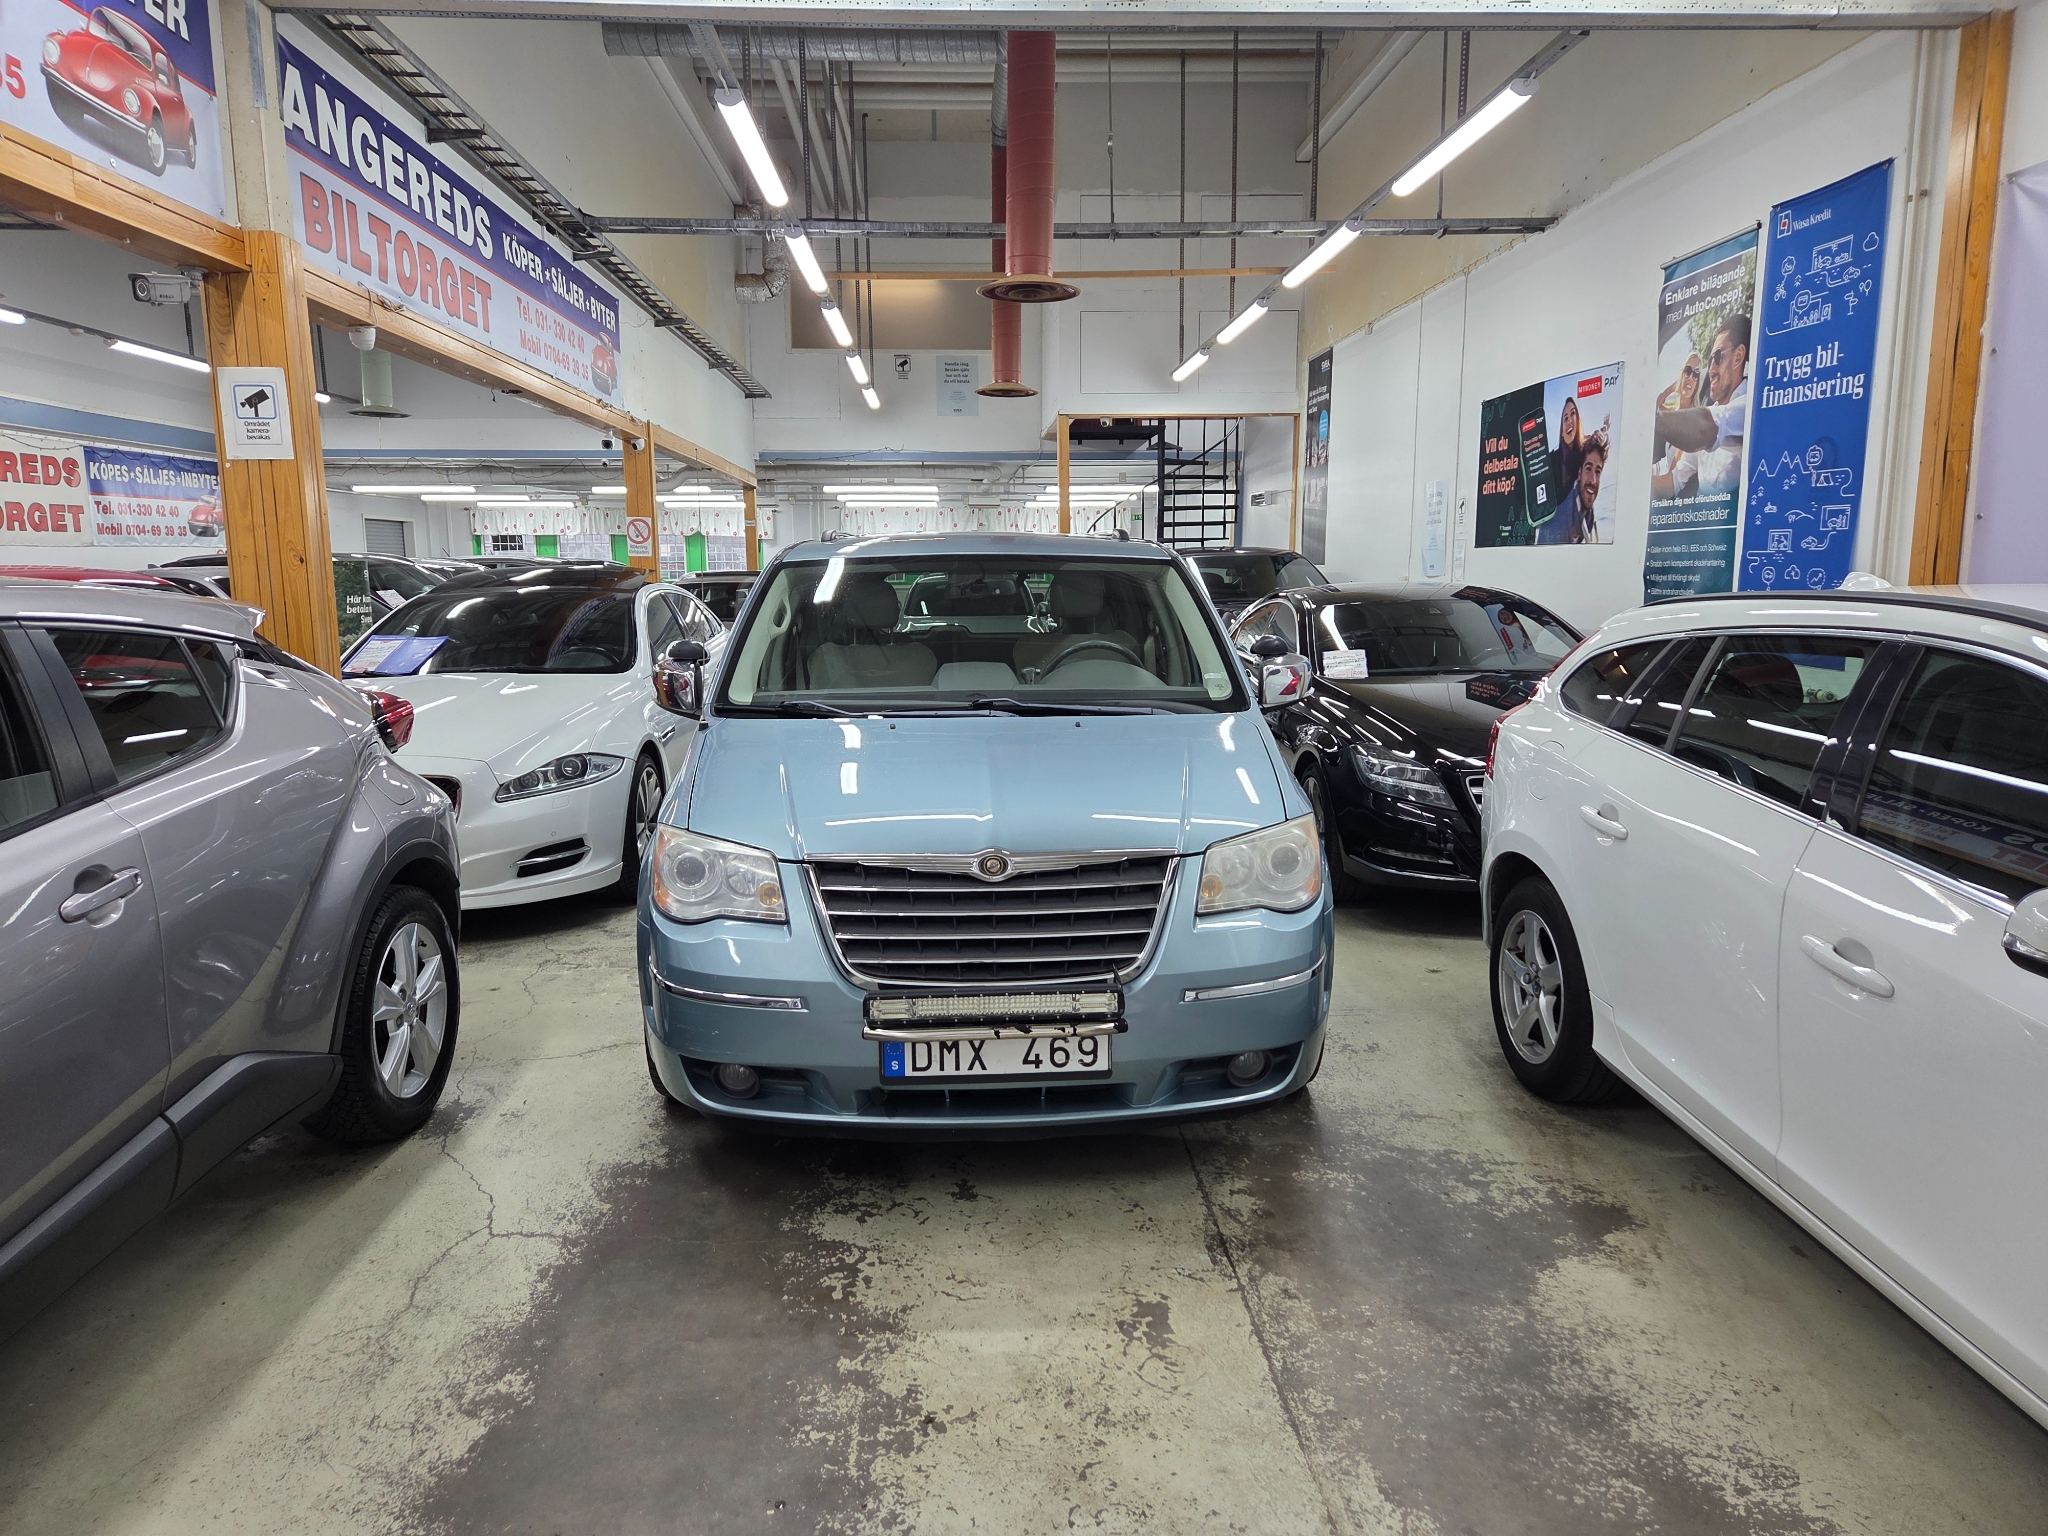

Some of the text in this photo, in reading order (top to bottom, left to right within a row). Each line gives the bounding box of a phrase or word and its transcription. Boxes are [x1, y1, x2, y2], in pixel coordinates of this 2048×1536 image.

[0, 52, 26, 100] 5
[283, 62, 616, 333] ANGEREDS KÖPER SÄLJER BYTER
[1793, 208, 1832, 231] Wasa Kredit
[300, 171, 492, 333] BILTORGET
[1665, 264, 1746, 305] Enklare bilägande
[1665, 284, 1743, 324] med AutoConcept
[517, 296, 533, 324] Tel.
[554, 319, 566, 343] 330
[568, 328, 575, 349] 42
[578, 334, 585, 354] 40
[520, 329, 541, 357] Mobil
[572, 358, 580, 376] 39
[582, 362, 589, 381] 35
[1765, 341, 1845, 382] Trygg bil-
[1578, 374, 1620, 393] MYMONEY PAY
[1761, 372, 1866, 409] finansiering
[244, 420, 270, 428] Området
[1485, 435, 1508, 454] Vill du
[89, 460, 129, 483] KÖPES
[135, 465, 176, 487] SÄLJES
[1483, 454, 1519, 475] delbetala
[1482, 475, 1516, 495] ditt köp?
[94, 501, 114, 515] Tel.
[155, 504, 167, 518] 42
[169, 505, 179, 518] 40
[1651, 492, 1731, 508] Försäkra dig mot oförutsedda
[1650, 506, 1730, 527] reparationskostnader
[96, 522, 122, 536] Mobil
[164, 525, 175, 537] 39
[177, 526, 188, 537] 35
[346, 595, 361, 604] Här
[911, 1035, 1099, 1072] DMX 469
[891, 1060, 899, 1071] S
